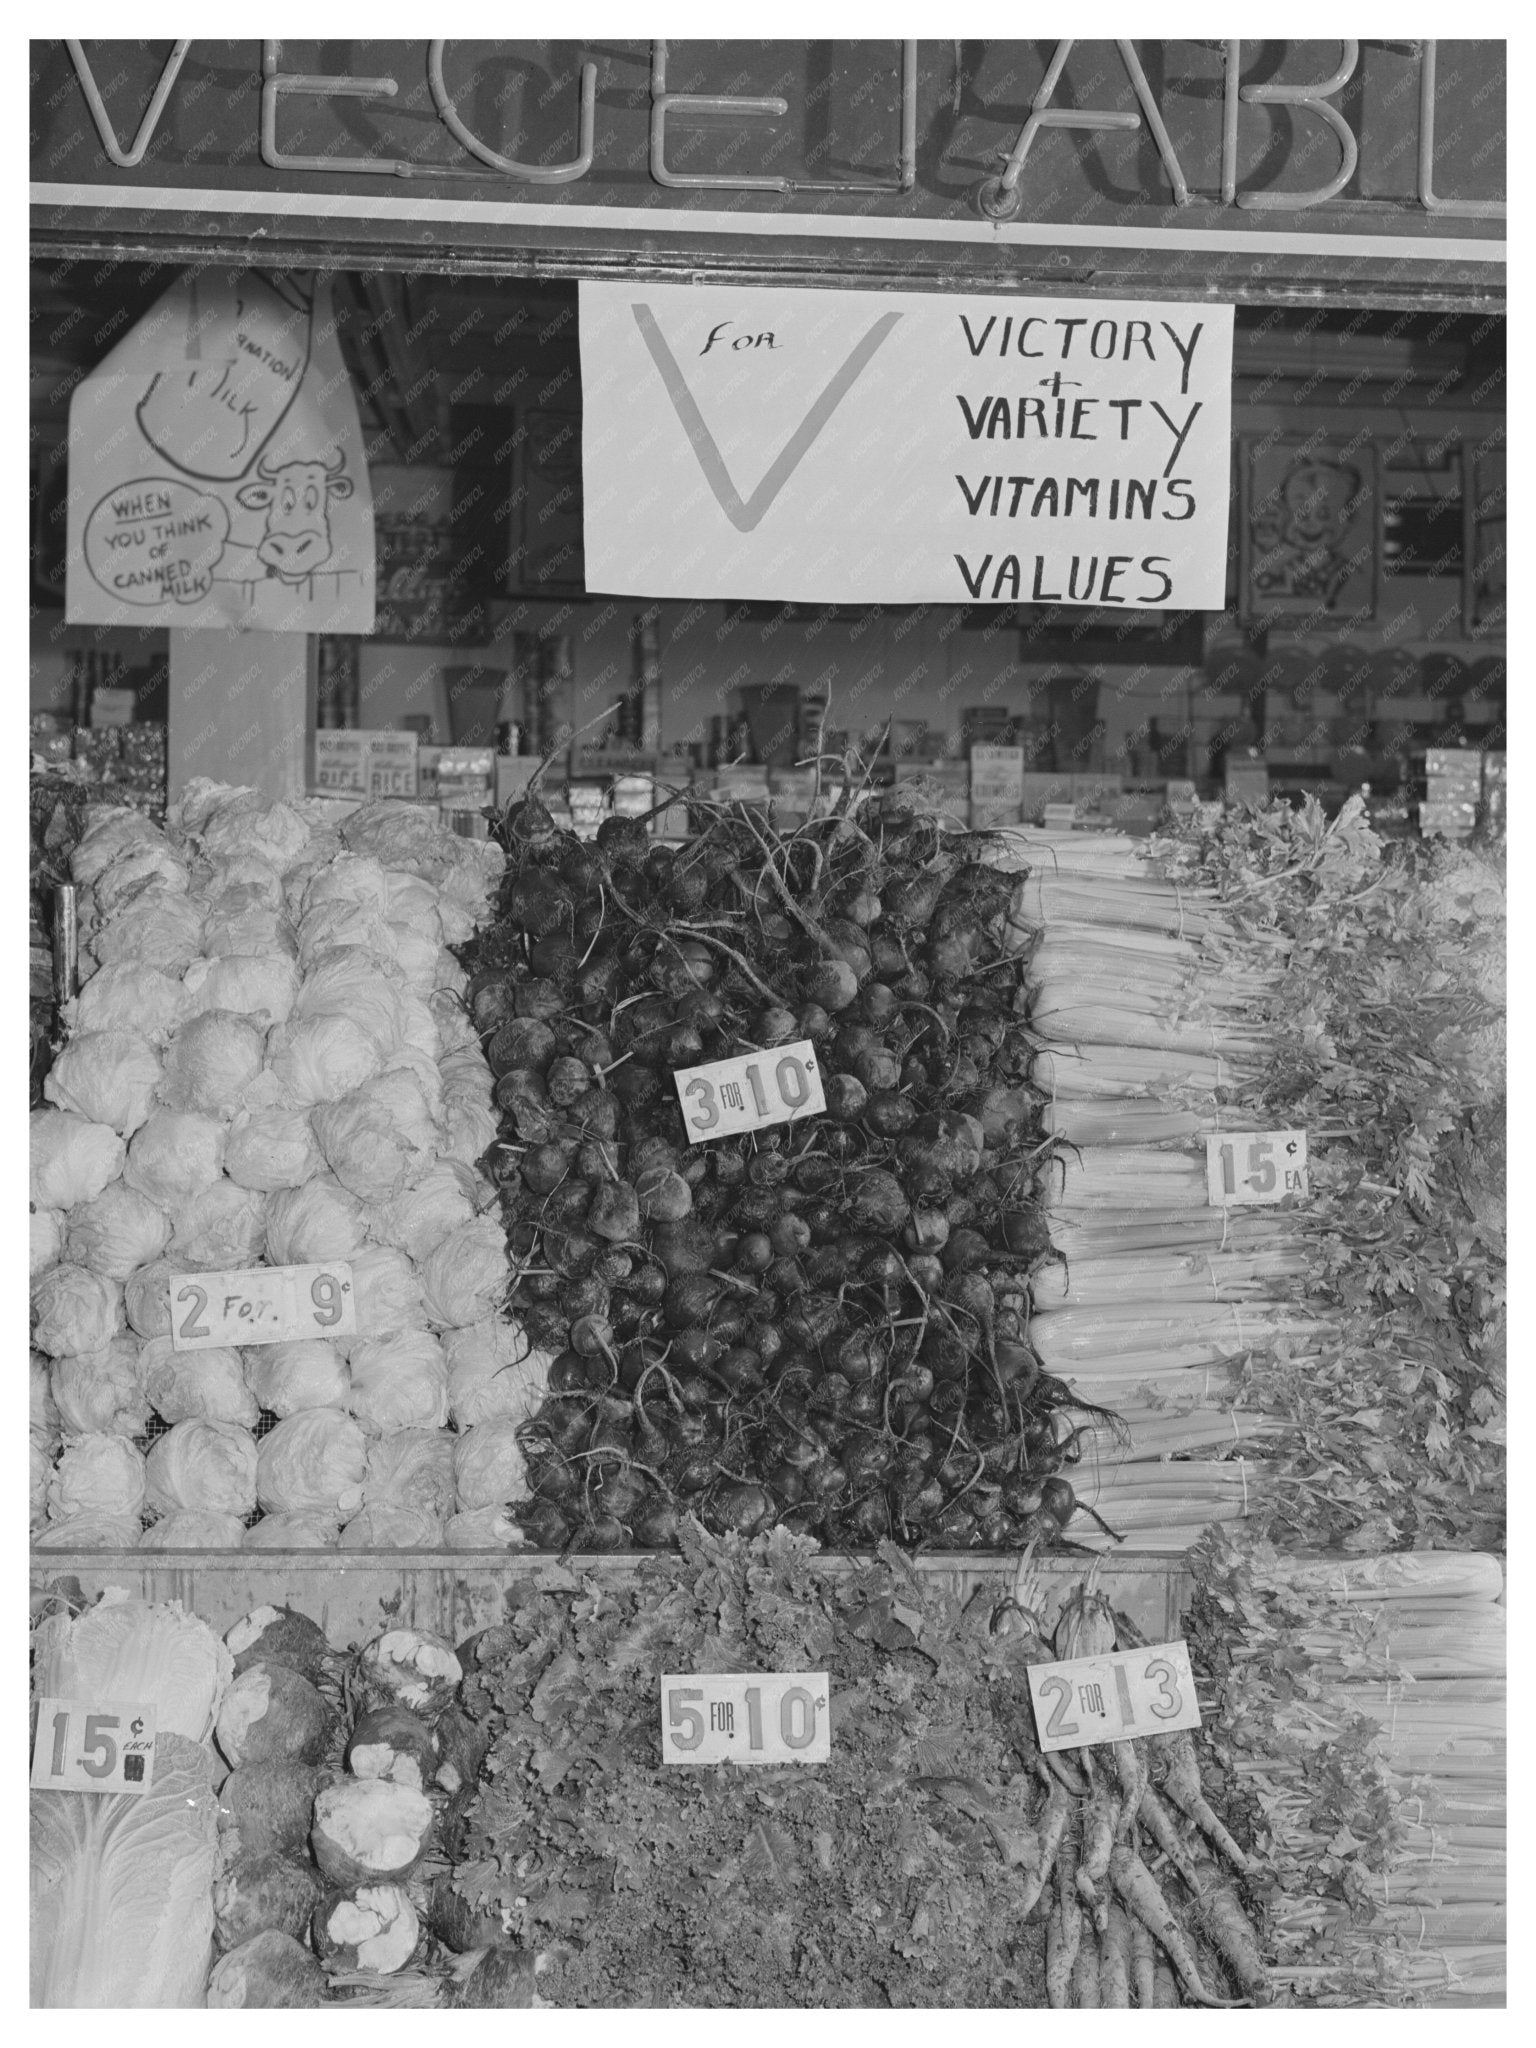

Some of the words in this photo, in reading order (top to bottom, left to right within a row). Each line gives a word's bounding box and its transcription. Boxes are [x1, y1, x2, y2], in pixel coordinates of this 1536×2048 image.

[958, 315, 1204, 394] VICTORY
[631, 303, 904, 533] V
[956, 395, 1203, 478] VARIETY
[111, 494, 171, 518] WHEN
[955, 475, 1196, 521] VITAMINS
[104, 530, 145, 550] YOU
[153, 513, 212, 539] THINK
[148, 542, 169, 559] OF
[113, 560, 191, 588] CANNED
[160, 576, 206, 599] MILK
[953, 554, 1173, 603] VALUES
[371, 771, 413, 792] RICE
[685, 1077, 719, 1130] 3
[720, 1082, 744, 1110] FOR
[1284, 1170, 1302, 1190] EA
[177, 1285, 210, 1338] 2
[668, 1688, 705, 1750] 5
[710, 1702, 735, 1731] FOR
[1039, 1675, 1079, 1738] 2
[1078, 1683, 1105, 1714] FOR
[1114, 1658, 1183, 1726] 13
[122, 1741, 153, 1751] EACH
